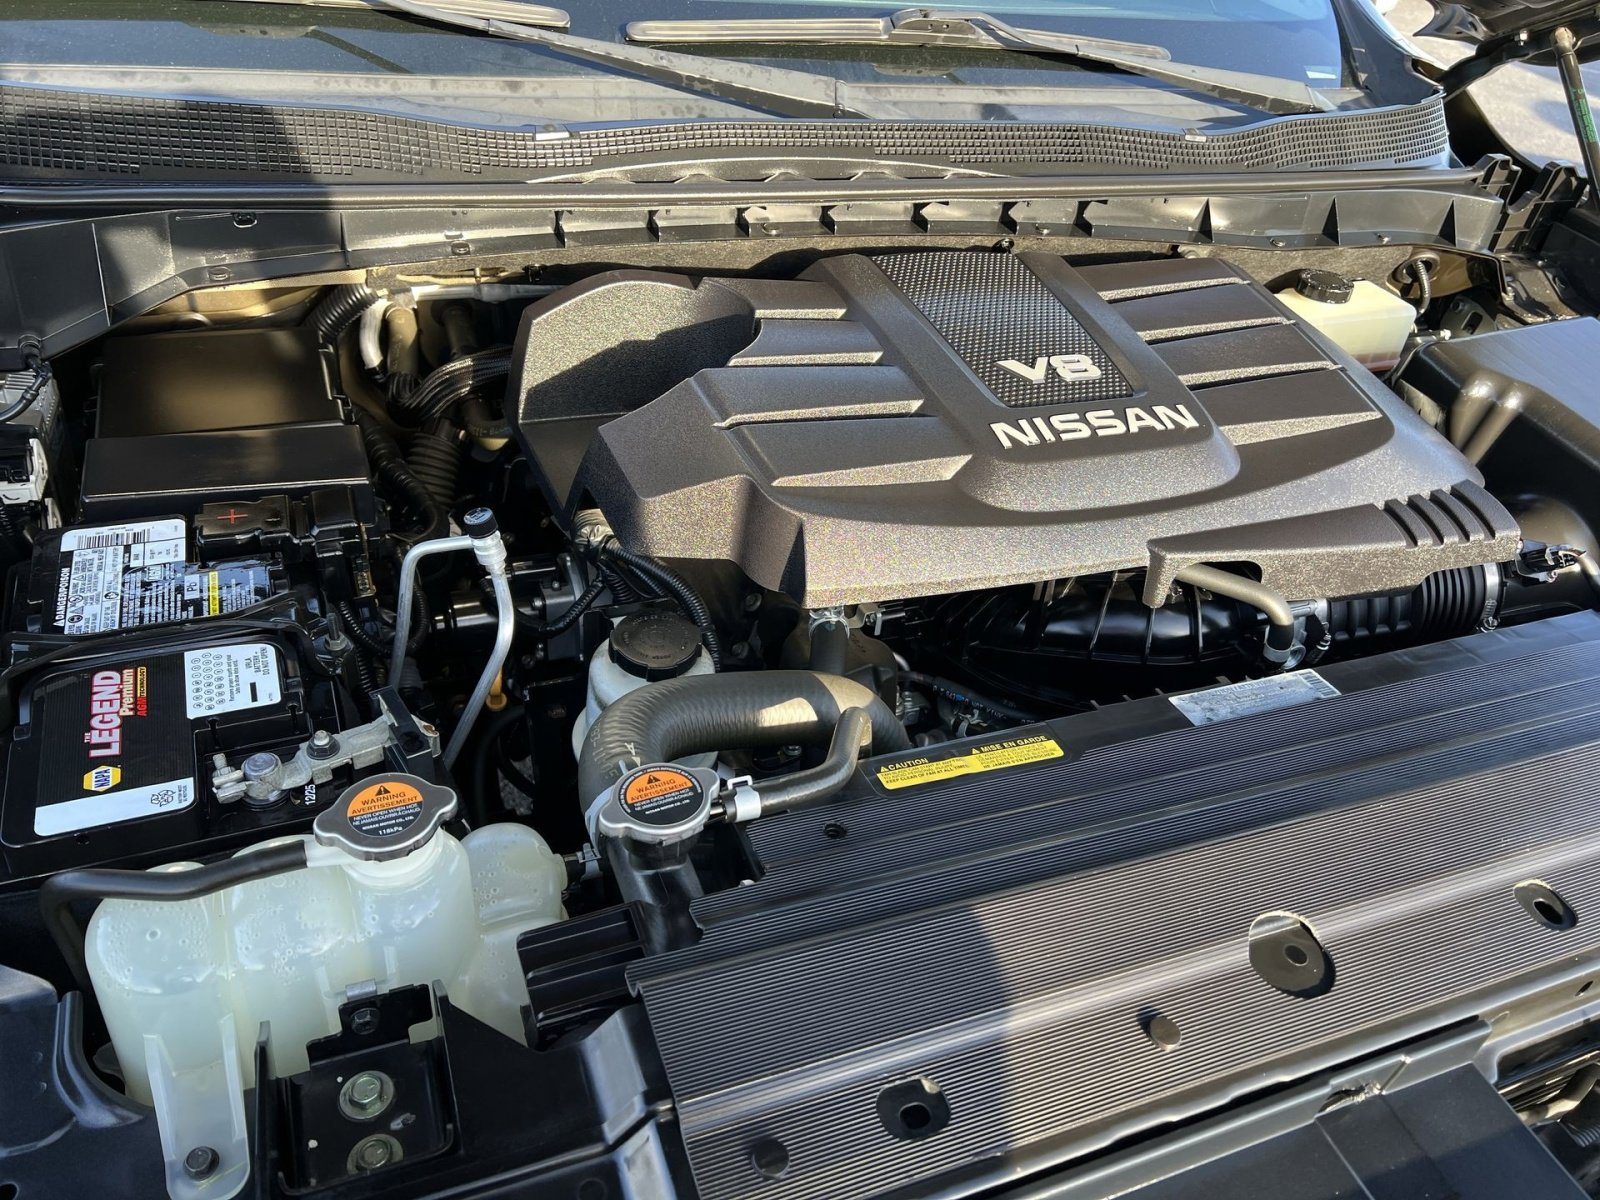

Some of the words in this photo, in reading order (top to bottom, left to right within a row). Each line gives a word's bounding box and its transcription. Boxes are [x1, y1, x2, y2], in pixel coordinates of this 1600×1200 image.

[995, 354, 1101, 384] V8
[989, 404, 1199, 449] NISSAN
[186, 580, 197, 593] Pb
[119, 668, 135, 716] Premium
[138, 667, 147, 697] TECHNOLOGY
[89, 670, 121, 758] LEGEND
[137, 696, 148, 717] AGM
[980, 744, 1002, 752] MISE
[1017, 736, 1047, 746] GARDE
[888, 758, 929, 770] CAUTION
[94, 768, 111, 789] NAPA
[636, 779, 676, 793] WARNING
[305, 784, 316, 806] 12/25
[362, 792, 406, 806] WARNING
[630, 782, 688, 802] AVERTISSEMENT
[352, 796, 418, 815] AVERTISSEMENT
